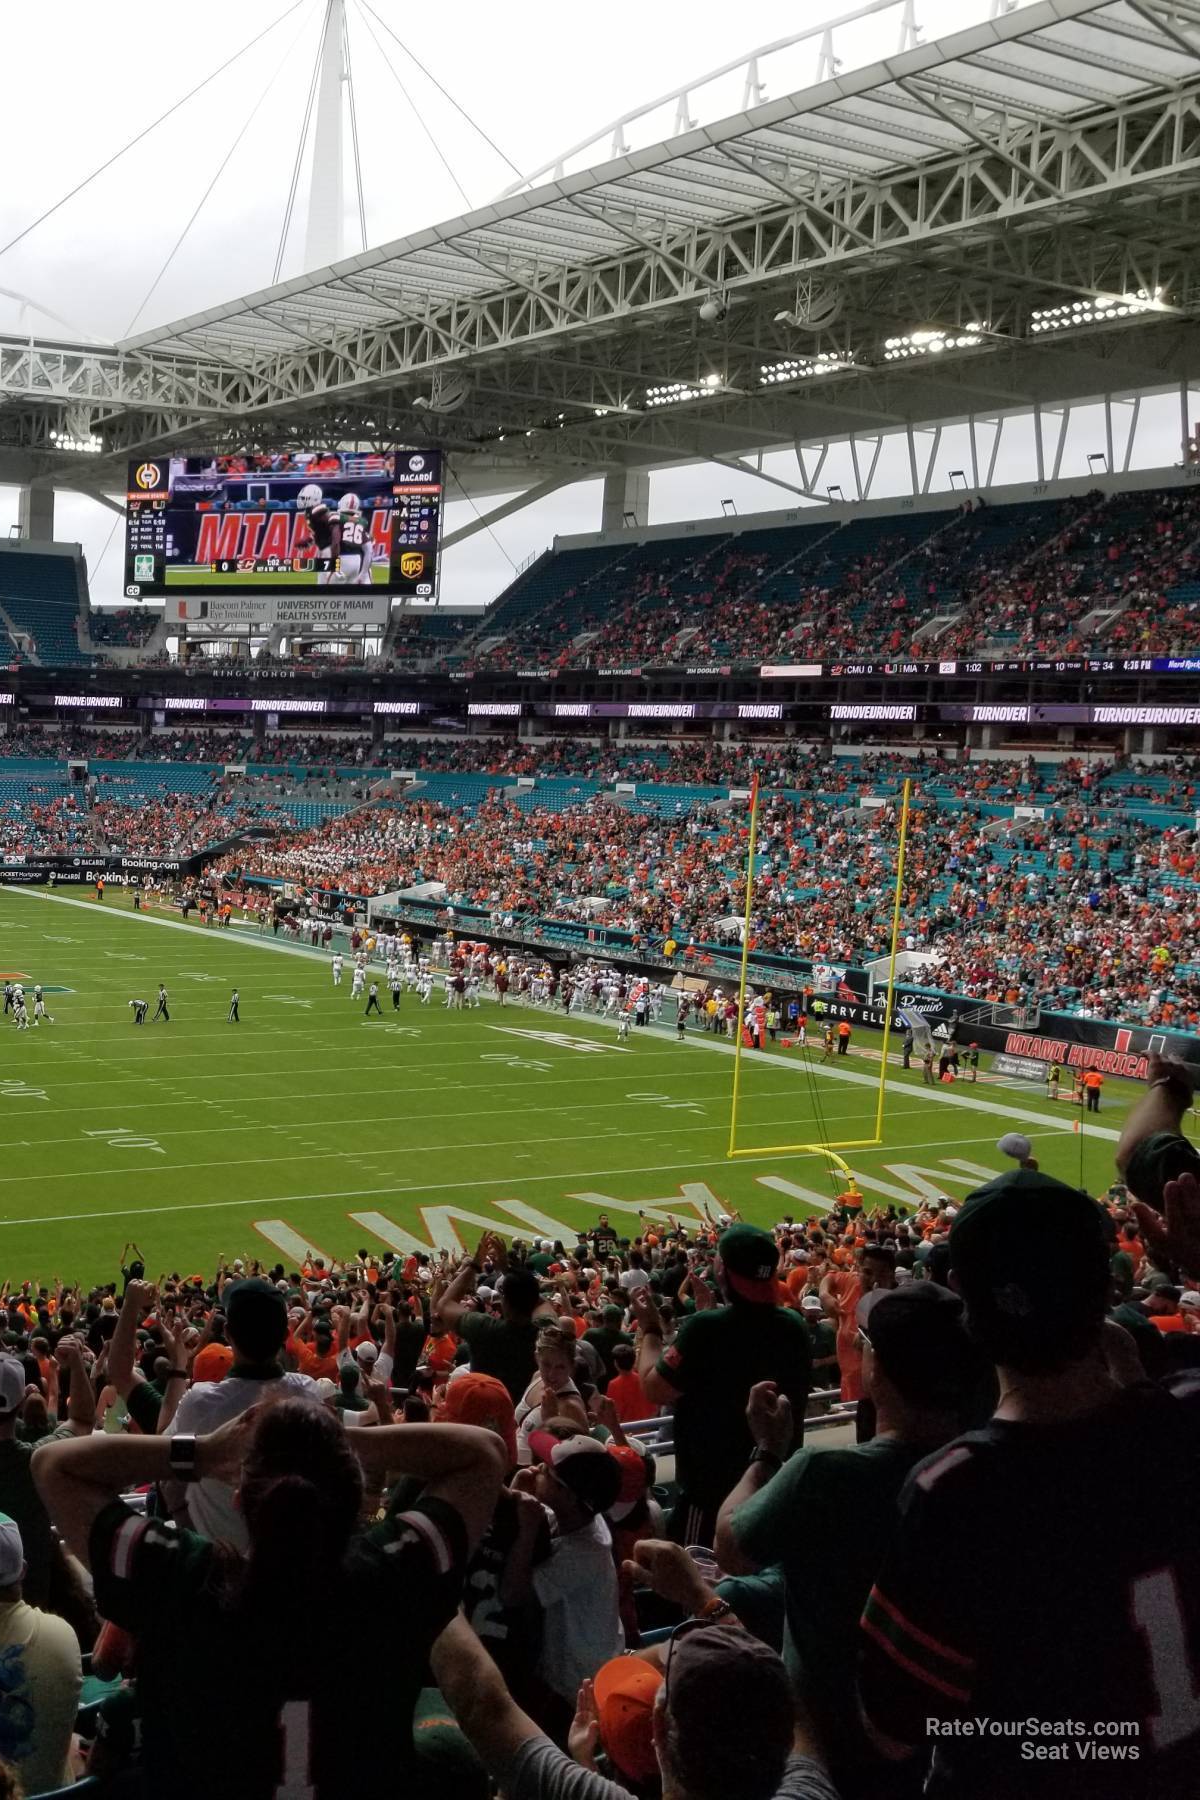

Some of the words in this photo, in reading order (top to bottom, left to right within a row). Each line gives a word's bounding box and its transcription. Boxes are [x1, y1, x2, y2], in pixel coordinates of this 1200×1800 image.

[400, 471, 432, 482] BACARDÍ
[343, 523, 364, 545] 26
[222, 562, 229, 571] 0
[323, 562, 330, 571] 7
[403, 560, 421, 579] ups
[128, 587, 139, 595] CC
[418, 586, 430, 594] CC
[210, 600, 239, 610] Bascom
[240, 601, 267, 611] Palmer
[277, 600, 328, 610] UNIVERSITY
[330, 600, 341, 610] OF
[343, 600, 373, 610] MIAMI
[210, 610, 222, 620] Eye
[225, 610, 254, 619] Institute
[277, 611, 310, 621] HEALTH
[312, 611, 346, 621] SYSTEM
[846, 665, 865, 674] CMU
[867, 665, 872, 674] 0
[903, 664, 918, 673] MIA
[924, 664, 929, 672] 7
[1055, 662, 1065, 671] 10
[1103, 662, 1114, 670] 34
[1140, 660, 1151, 670] PM
[1168, 660, 1185, 669] Hard
[213, 669, 242, 677] RING
[253, 670, 295, 678] HONOR
[165, 698, 204, 708] TURNOVER
[373, 702, 416, 713] TURNOVER
[555, 704, 588, 716] TURNOVER
[738, 705, 780, 718] TURNOVER
[973, 706, 1026, 721] TURNOVER
[81, 858, 105, 866] BACARDÍ
[122, 858, 179, 870] Booking.com
[57, 871, 81, 880] BACARDÍ
[823, 1003, 857, 1020] ERRY
[1005, 1033, 1068, 1063] MIAMI
[81, 1128, 154, 1148] 10
[275, 1700, 317, 1800] 1
